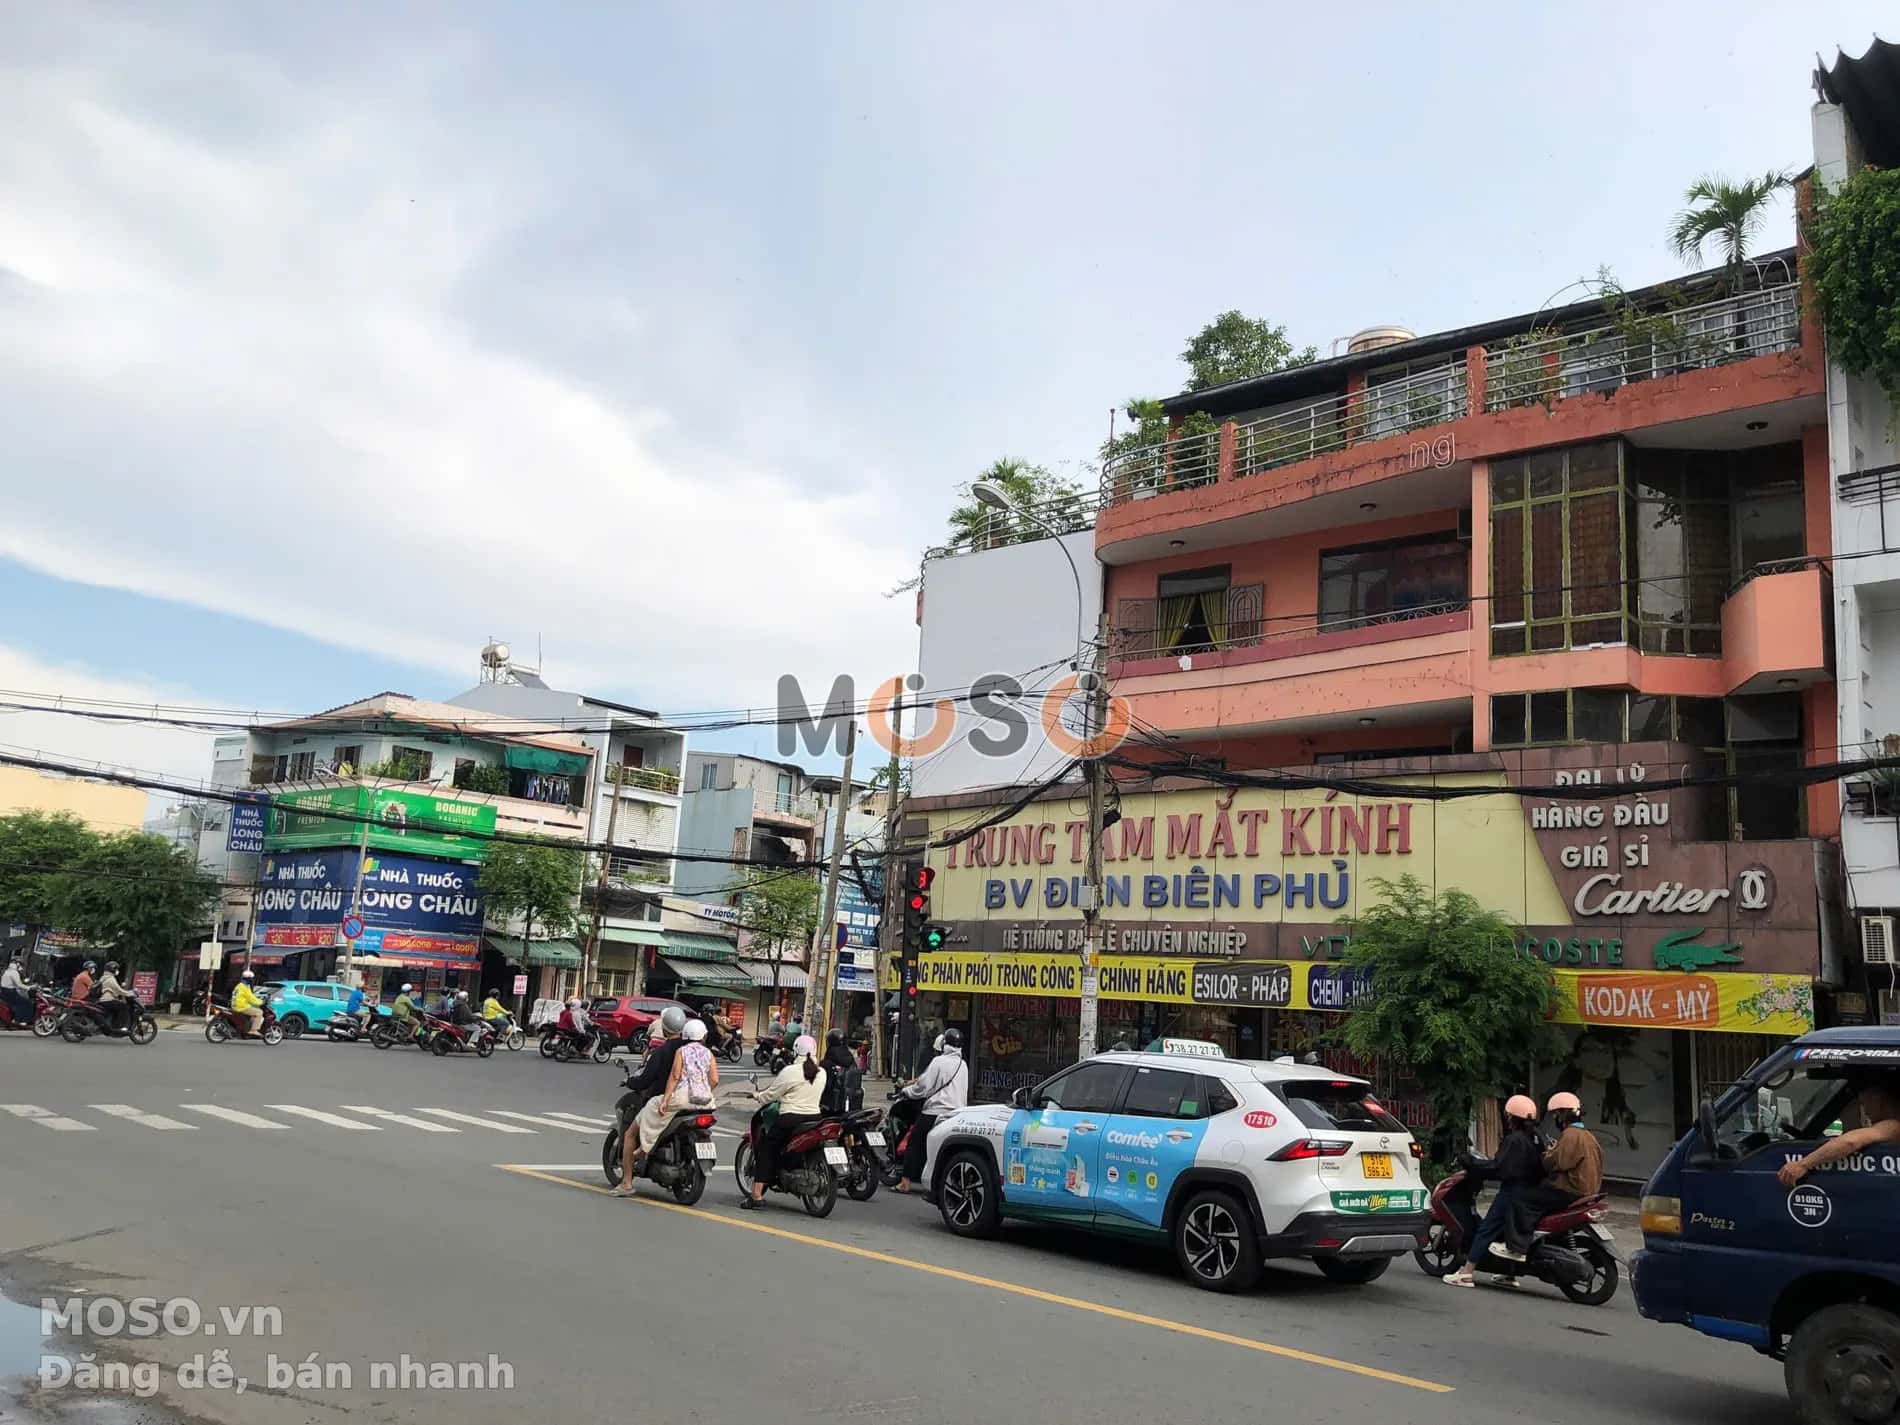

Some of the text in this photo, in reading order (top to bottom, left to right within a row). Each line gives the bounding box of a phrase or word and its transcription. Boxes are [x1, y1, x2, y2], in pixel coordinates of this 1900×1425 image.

[235, 816, 264, 827] THUỐC
[241, 808, 260, 818] NHÀ
[1531, 792, 1670, 829] HÀNG ĐẦU
[232, 828, 264, 839] LONG
[943, 823, 1056, 869] TRUNG
[1166, 787, 1269, 860] MẮT
[1280, 790, 1414, 856] KÍNH
[230, 839, 263, 851] CHÂU
[1560, 833, 1649, 868] GIÁ SỈ
[278, 858, 326, 880] NHÀ THUỐC
[380, 868, 464, 890] NHÀ THUỐC
[984, 858, 1350, 910] BV ĐIN BIÊN PHỦ
[300, 881, 342, 911] CHÂU
[419, 891, 478, 917] CHÂU
[1573, 872, 1732, 917] Cartier
[1021, 919, 1064, 951] THỐNG
[1121, 923, 1183, 954] CHUYÊN
[1186, 925, 1249, 960] NGHIỆP
[930, 956, 963, 985] PHÂN
[965, 953, 993, 987] PHỐI
[996, 957, 1038, 989] TRÒNG
[1039, 958, 1076, 990] CÔNG
[1099, 961, 1142, 994] CHÍNH
[1146, 961, 1187, 996] HÃNG
[1193, 972, 1239, 1000] ESILOR
[1251, 968, 1290, 1002] PHÁP
[1310, 978, 1344, 1006] CHEMI
[1583, 985, 1655, 1020] KODAK
[1676, 982, 1711, 1022] MỸ
[1836, 1152, 1877, 1172] ĐỨC
